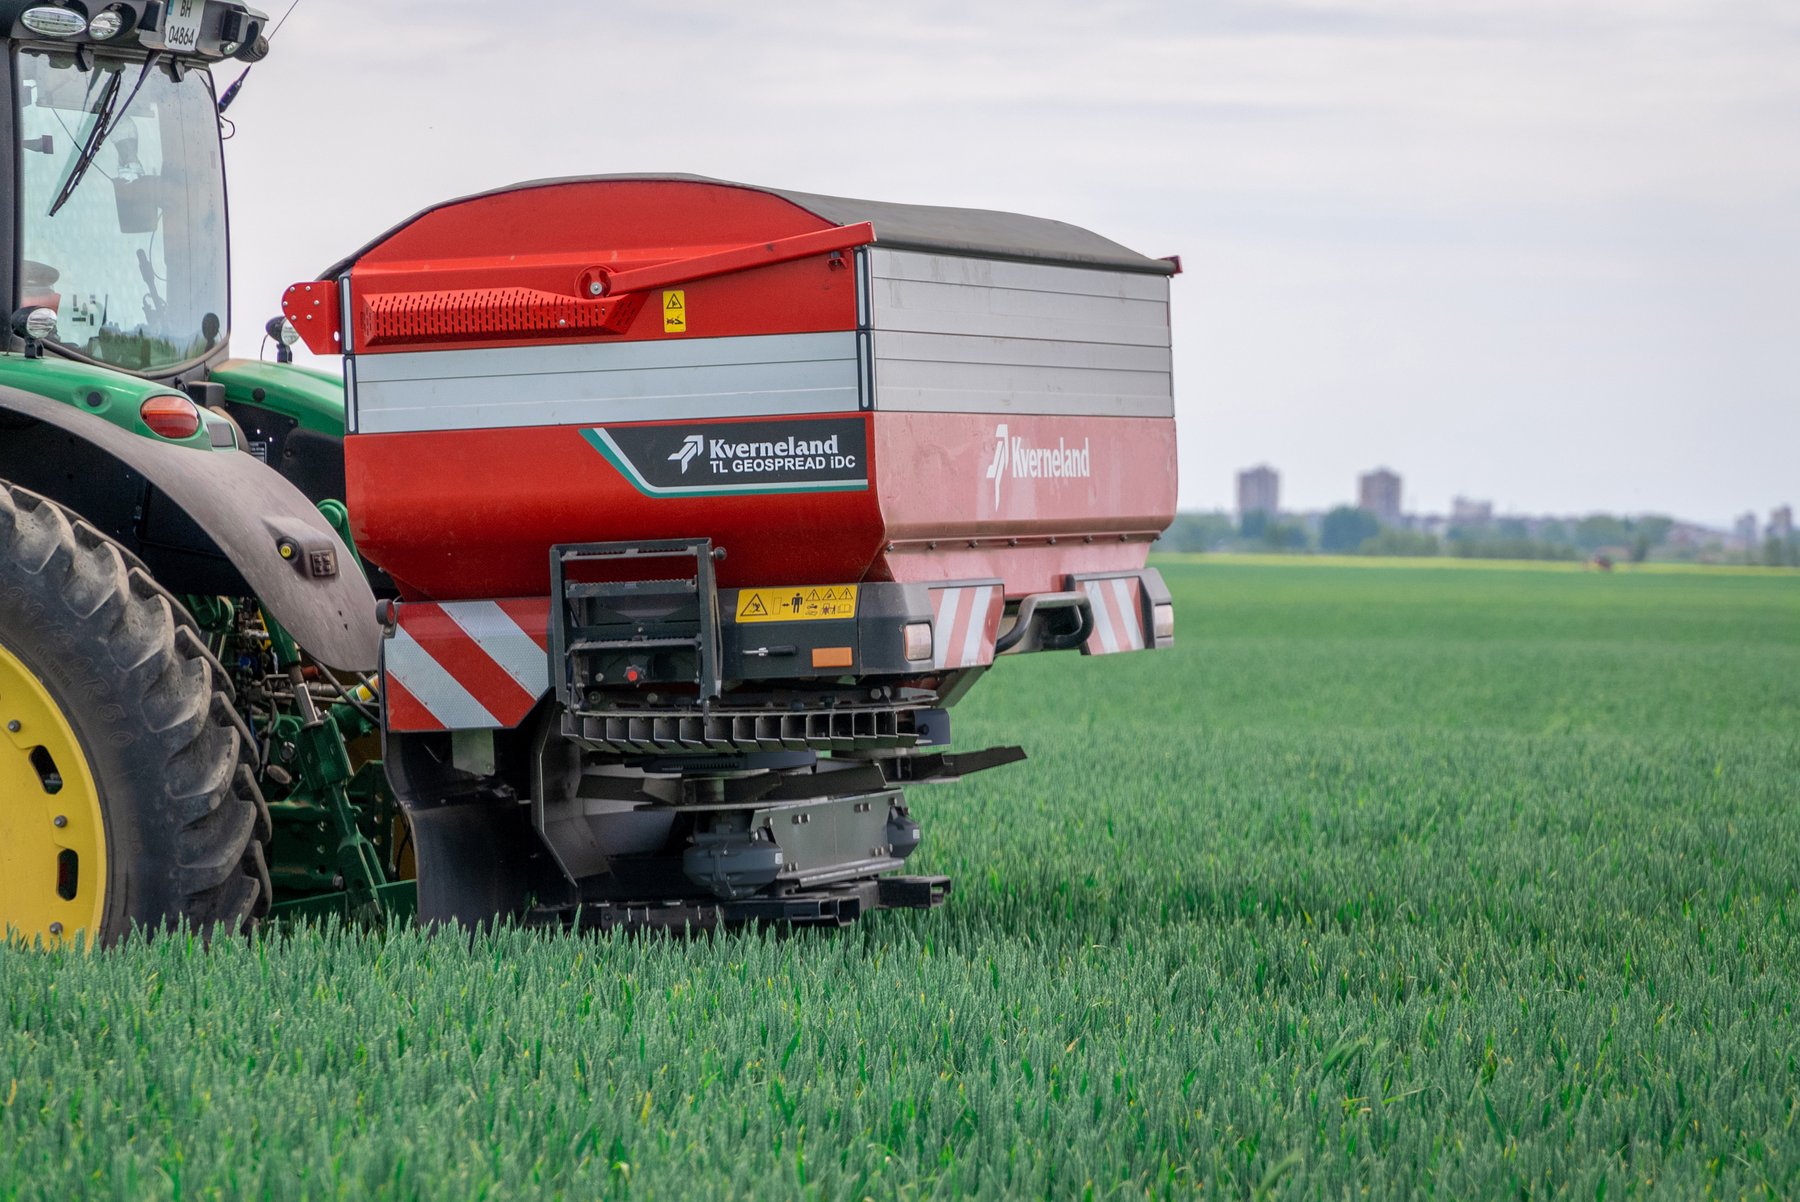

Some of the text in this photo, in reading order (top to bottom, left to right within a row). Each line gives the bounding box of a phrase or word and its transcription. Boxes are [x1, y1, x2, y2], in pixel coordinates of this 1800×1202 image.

[180, 0, 192, 18] BH
[168, 25, 195, 46] 04864
[709, 434, 839, 459] Kverneland
[1011, 436, 1090, 478] Kverneland
[710, 455, 856, 473] TL GEOSPREAD iDC
